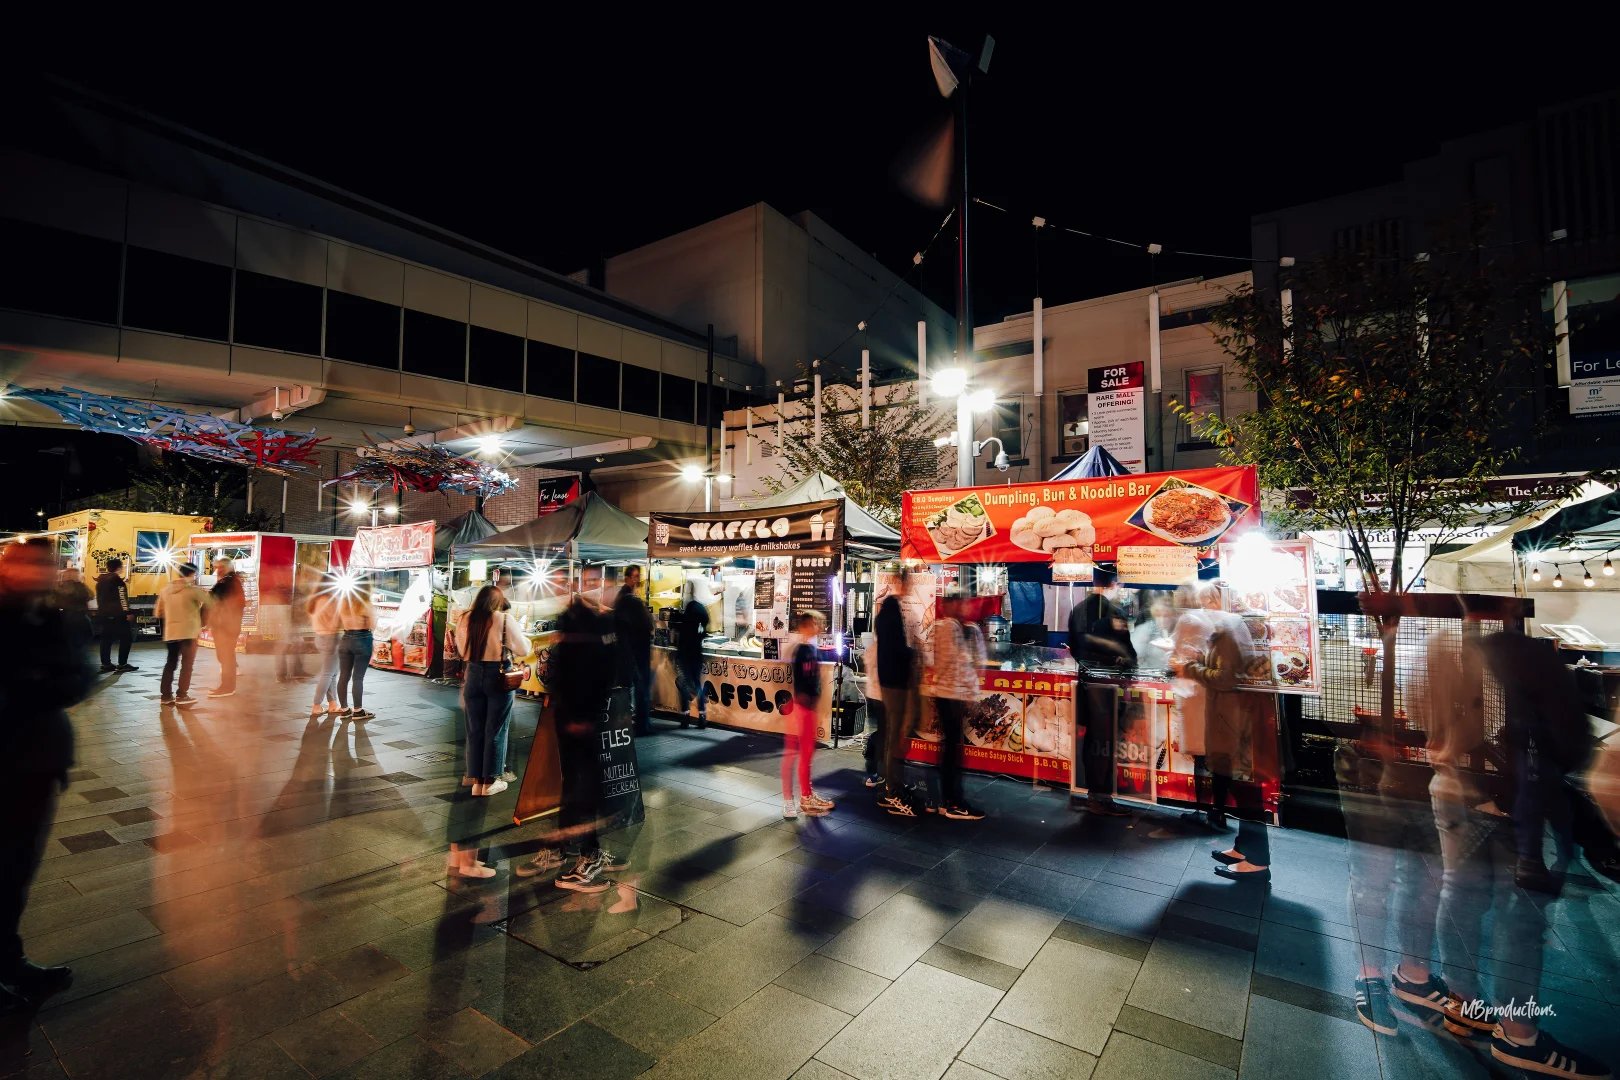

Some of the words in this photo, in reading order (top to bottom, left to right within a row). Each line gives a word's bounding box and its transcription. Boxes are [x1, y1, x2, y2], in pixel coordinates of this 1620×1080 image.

[1574, 361, 1600, 372] For
[1104, 368, 1126, 378] FOR
[1100, 376, 1130, 388] SALE
[1098, 399, 1134, 408] OFFERING!
[539, 488, 550, 502] For
[984, 490, 1040, 507] Dumpling,
[1043, 488, 1065, 502] Bun
[1069, 487, 1077, 500] &
[1080, 484, 1125, 500] Noodle
[1128, 482, 1151, 497] Bar
[1506, 486, 1530, 496] The
[679, 545, 696, 553] sweet
[703, 544, 727, 554] savoury
[729, 543, 753, 552] waffles
[761, 541, 800, 551] milkshakes
[1094, 544, 1112, 553] Bun
[795, 556, 832, 567] SWEET
[702, 680, 794, 715] AFFLO
[601, 728, 631, 750] FLES
[911, 740, 928, 751] Fried
[964, 748, 989, 759] Chicken
[989, 750, 1007, 762] Satay
[1008, 753, 1024, 763] Stick
[1034, 757, 1058, 769] B.B.Q
[603, 762, 635, 780] NUTELLA
